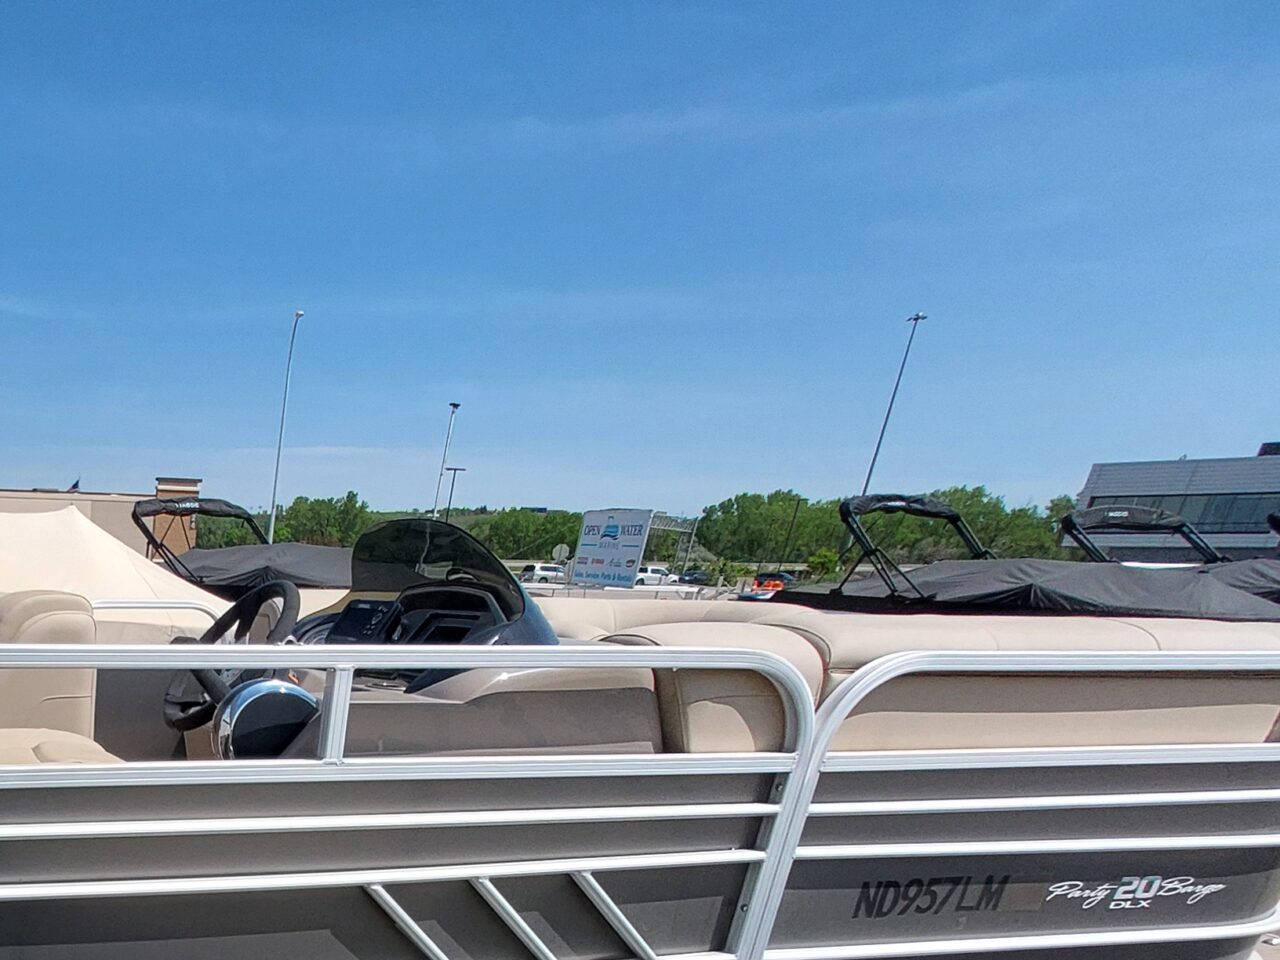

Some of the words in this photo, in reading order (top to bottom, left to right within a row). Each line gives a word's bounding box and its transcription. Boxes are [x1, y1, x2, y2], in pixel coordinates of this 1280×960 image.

[584, 524, 601, 536] OPEN
[621, 524, 643, 536] WATER
[852, 875, 1011, 919] ND957LM
[1046, 881, 1118, 909] Party
[1113, 876, 1163, 900] 20
[1157, 877, 1227, 904] Barge
[1109, 900, 1152, 909] DLX
